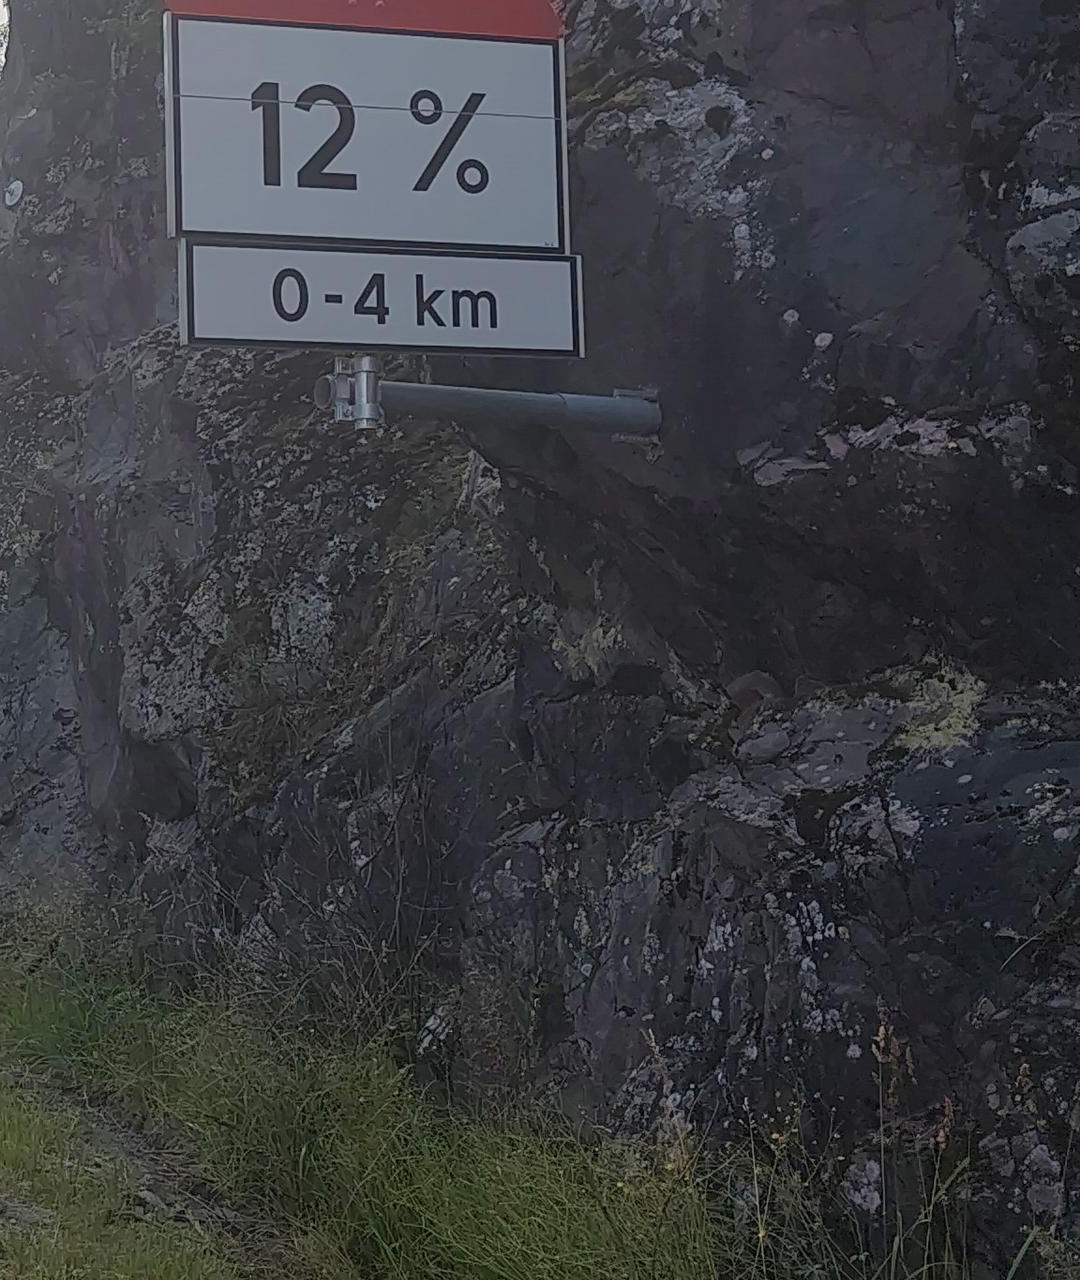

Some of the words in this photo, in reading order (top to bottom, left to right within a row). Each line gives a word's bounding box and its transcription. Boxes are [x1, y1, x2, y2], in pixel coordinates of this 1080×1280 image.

[250, 81, 358, 191] 12
[409, 89, 490, 195] %
[272, 267, 390, 325] 0-4
[415, 273, 498, 329] km
